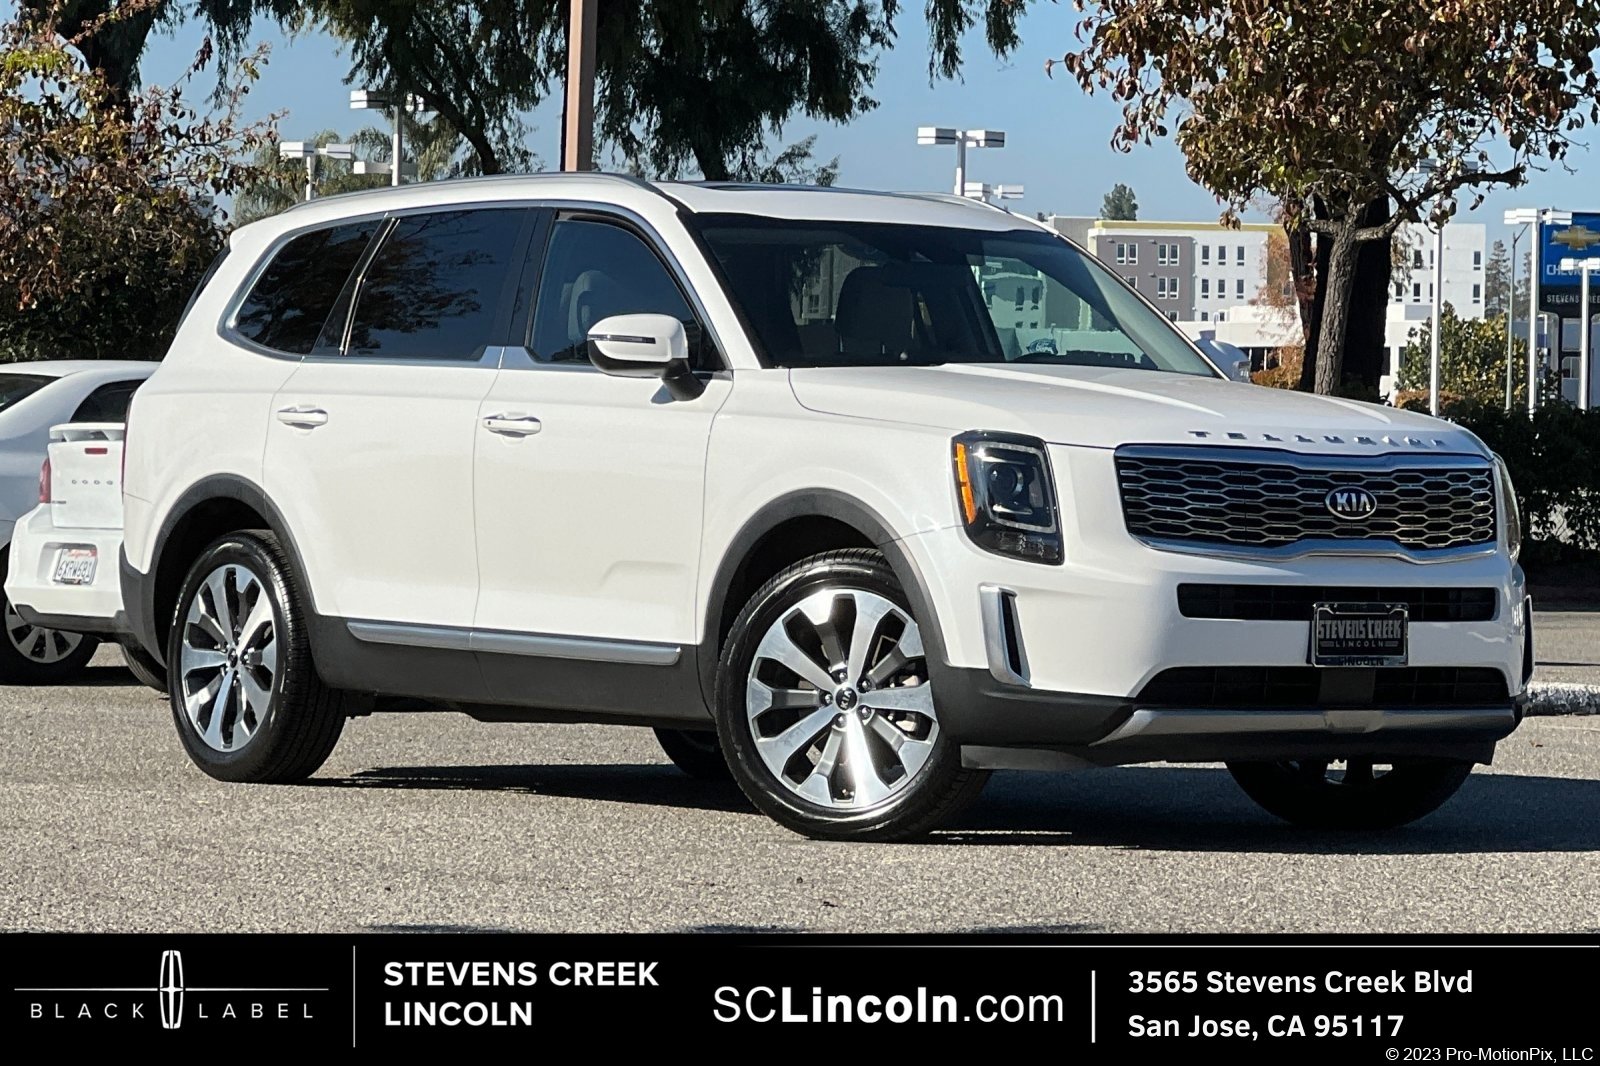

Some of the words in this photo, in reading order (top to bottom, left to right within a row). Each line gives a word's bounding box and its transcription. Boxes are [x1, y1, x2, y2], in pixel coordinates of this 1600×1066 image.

[1546, 294, 1580, 303] STEVENS
[1335, 493, 1371, 511] KIA
[1318, 619, 1366, 639] STEVENS
[1367, 618, 1402, 639] CREEK
[1335, 640, 1384, 648] LINCOLN
[840, 690, 853, 709] KIA
